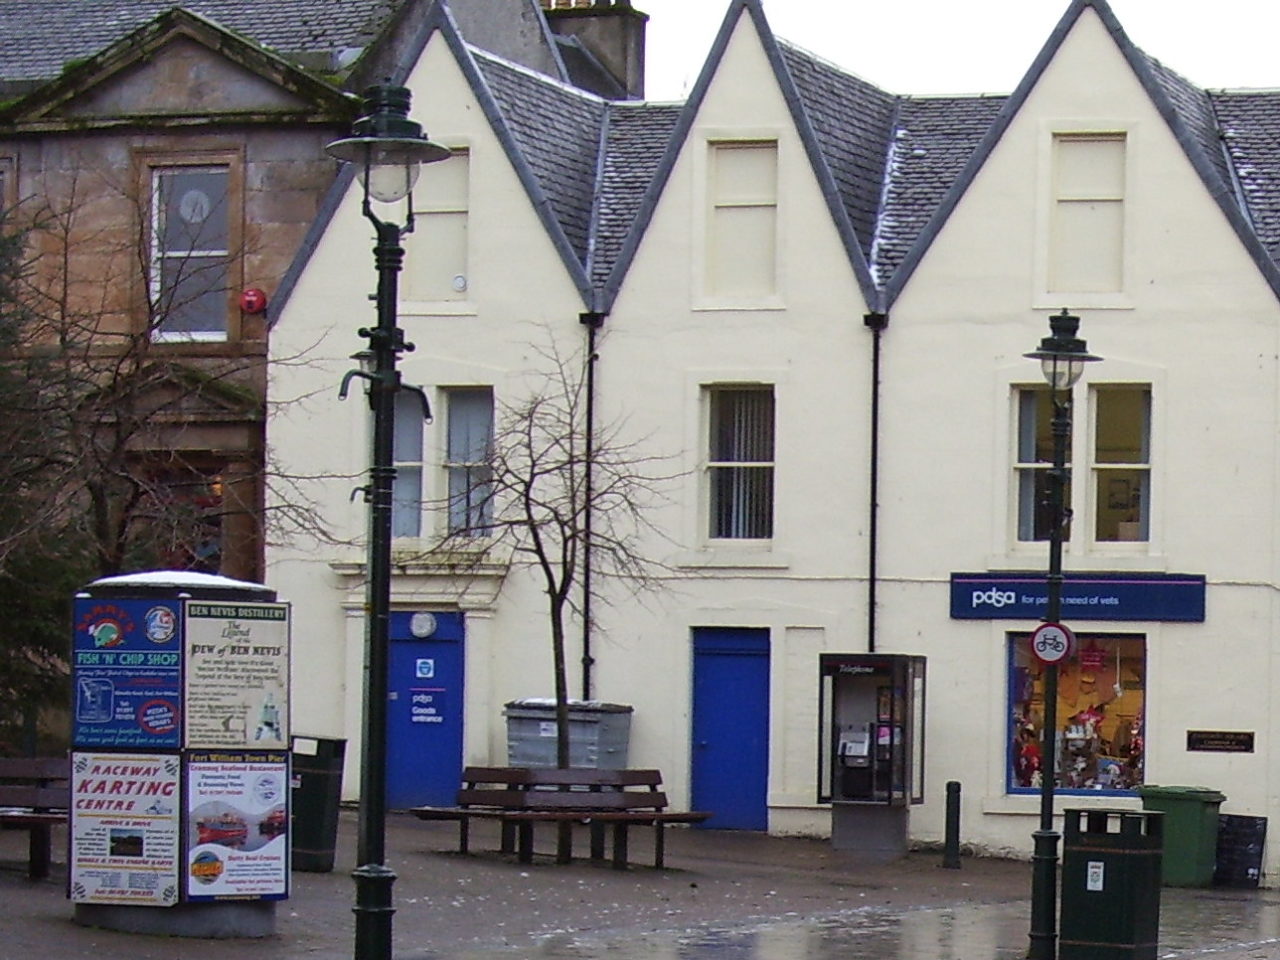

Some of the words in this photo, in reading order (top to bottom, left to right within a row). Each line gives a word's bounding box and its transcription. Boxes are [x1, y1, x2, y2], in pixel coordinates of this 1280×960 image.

[972, 587, 1016, 608] pdsa
[1021, 595, 1034, 604] for
[1065, 596, 1088, 605] need
[1089, 596, 1099, 605] of
[1100, 596, 1119, 605] vets
[190, 606, 209, 616] BEN
[210, 607, 237, 617] NEVIS
[239, 607, 285, 618] DISTILLERY
[230, 646, 250, 655] BEN
[252, 646, 281, 656] NEVIS
[77, 653, 99, 664] FISH
[119, 654, 144, 665] CHIP
[147, 654, 178, 665] SHOP
[209, 754, 242, 762] William
[91, 765, 160, 776] RACEWAY
[76, 779, 177, 796] KARTING
[76, 799, 136, 811] CENTRE
